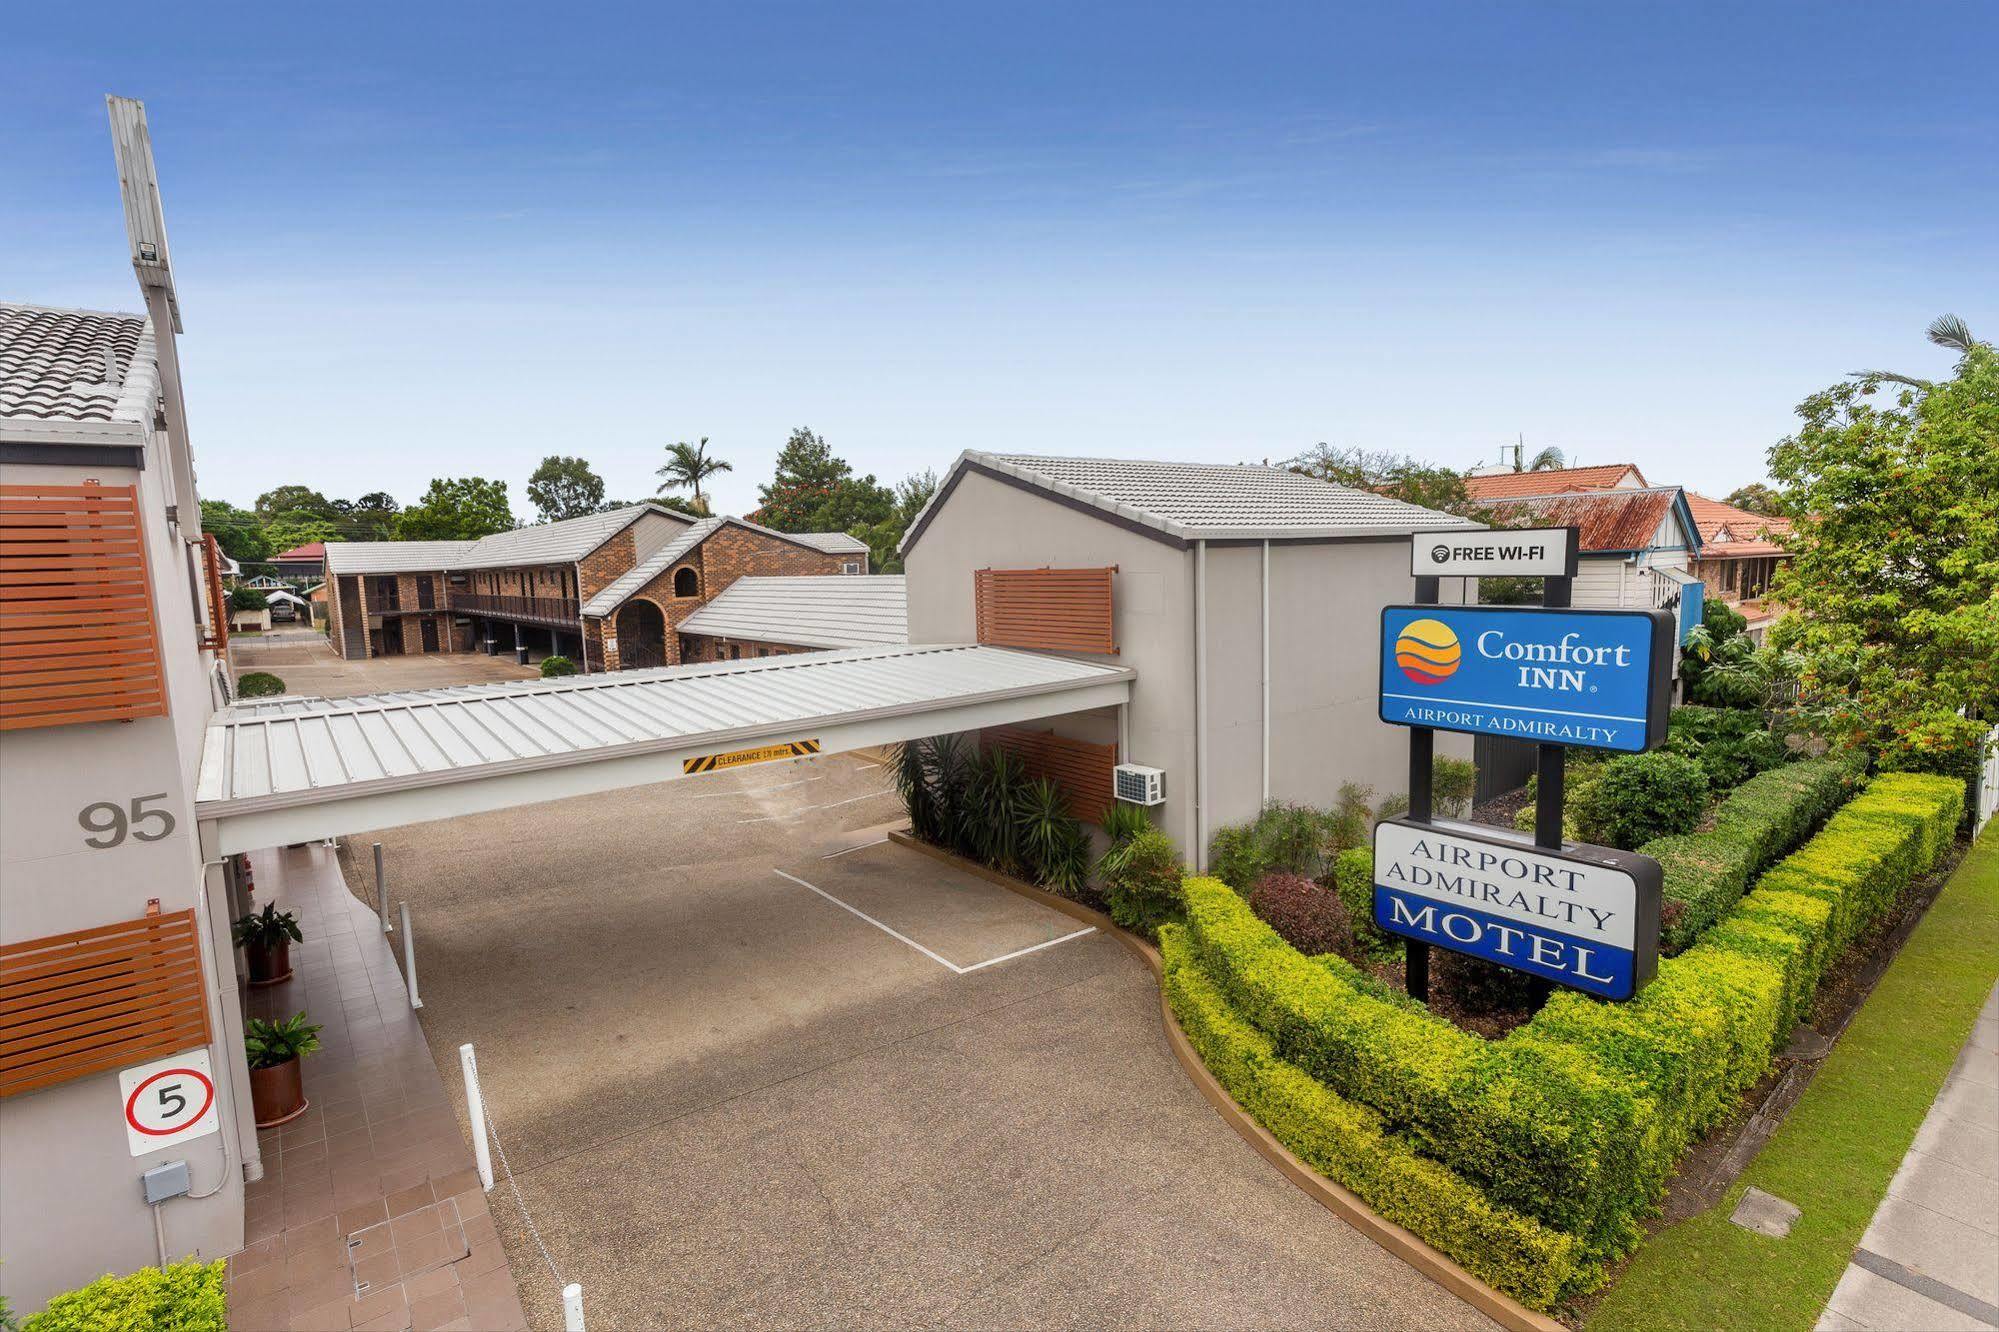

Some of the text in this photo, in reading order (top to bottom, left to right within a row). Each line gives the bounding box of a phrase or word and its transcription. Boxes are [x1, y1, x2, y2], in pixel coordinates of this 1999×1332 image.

[1452, 546, 1544, 561] FREE WI-FI
[1477, 630, 1631, 667] Comfort
[1517, 667, 1586, 692] INN
[1404, 707, 1618, 743] AIRPORT ADMIRALTY
[718, 752, 761, 765] CLEARANCE
[78, 792, 175, 849] 95
[1410, 839, 1585, 892] AIRPORT
[1385, 861, 1615, 932] ADMIRALTY
[1390, 896, 1614, 984] MOTEL
[158, 1083, 187, 1119] 5
